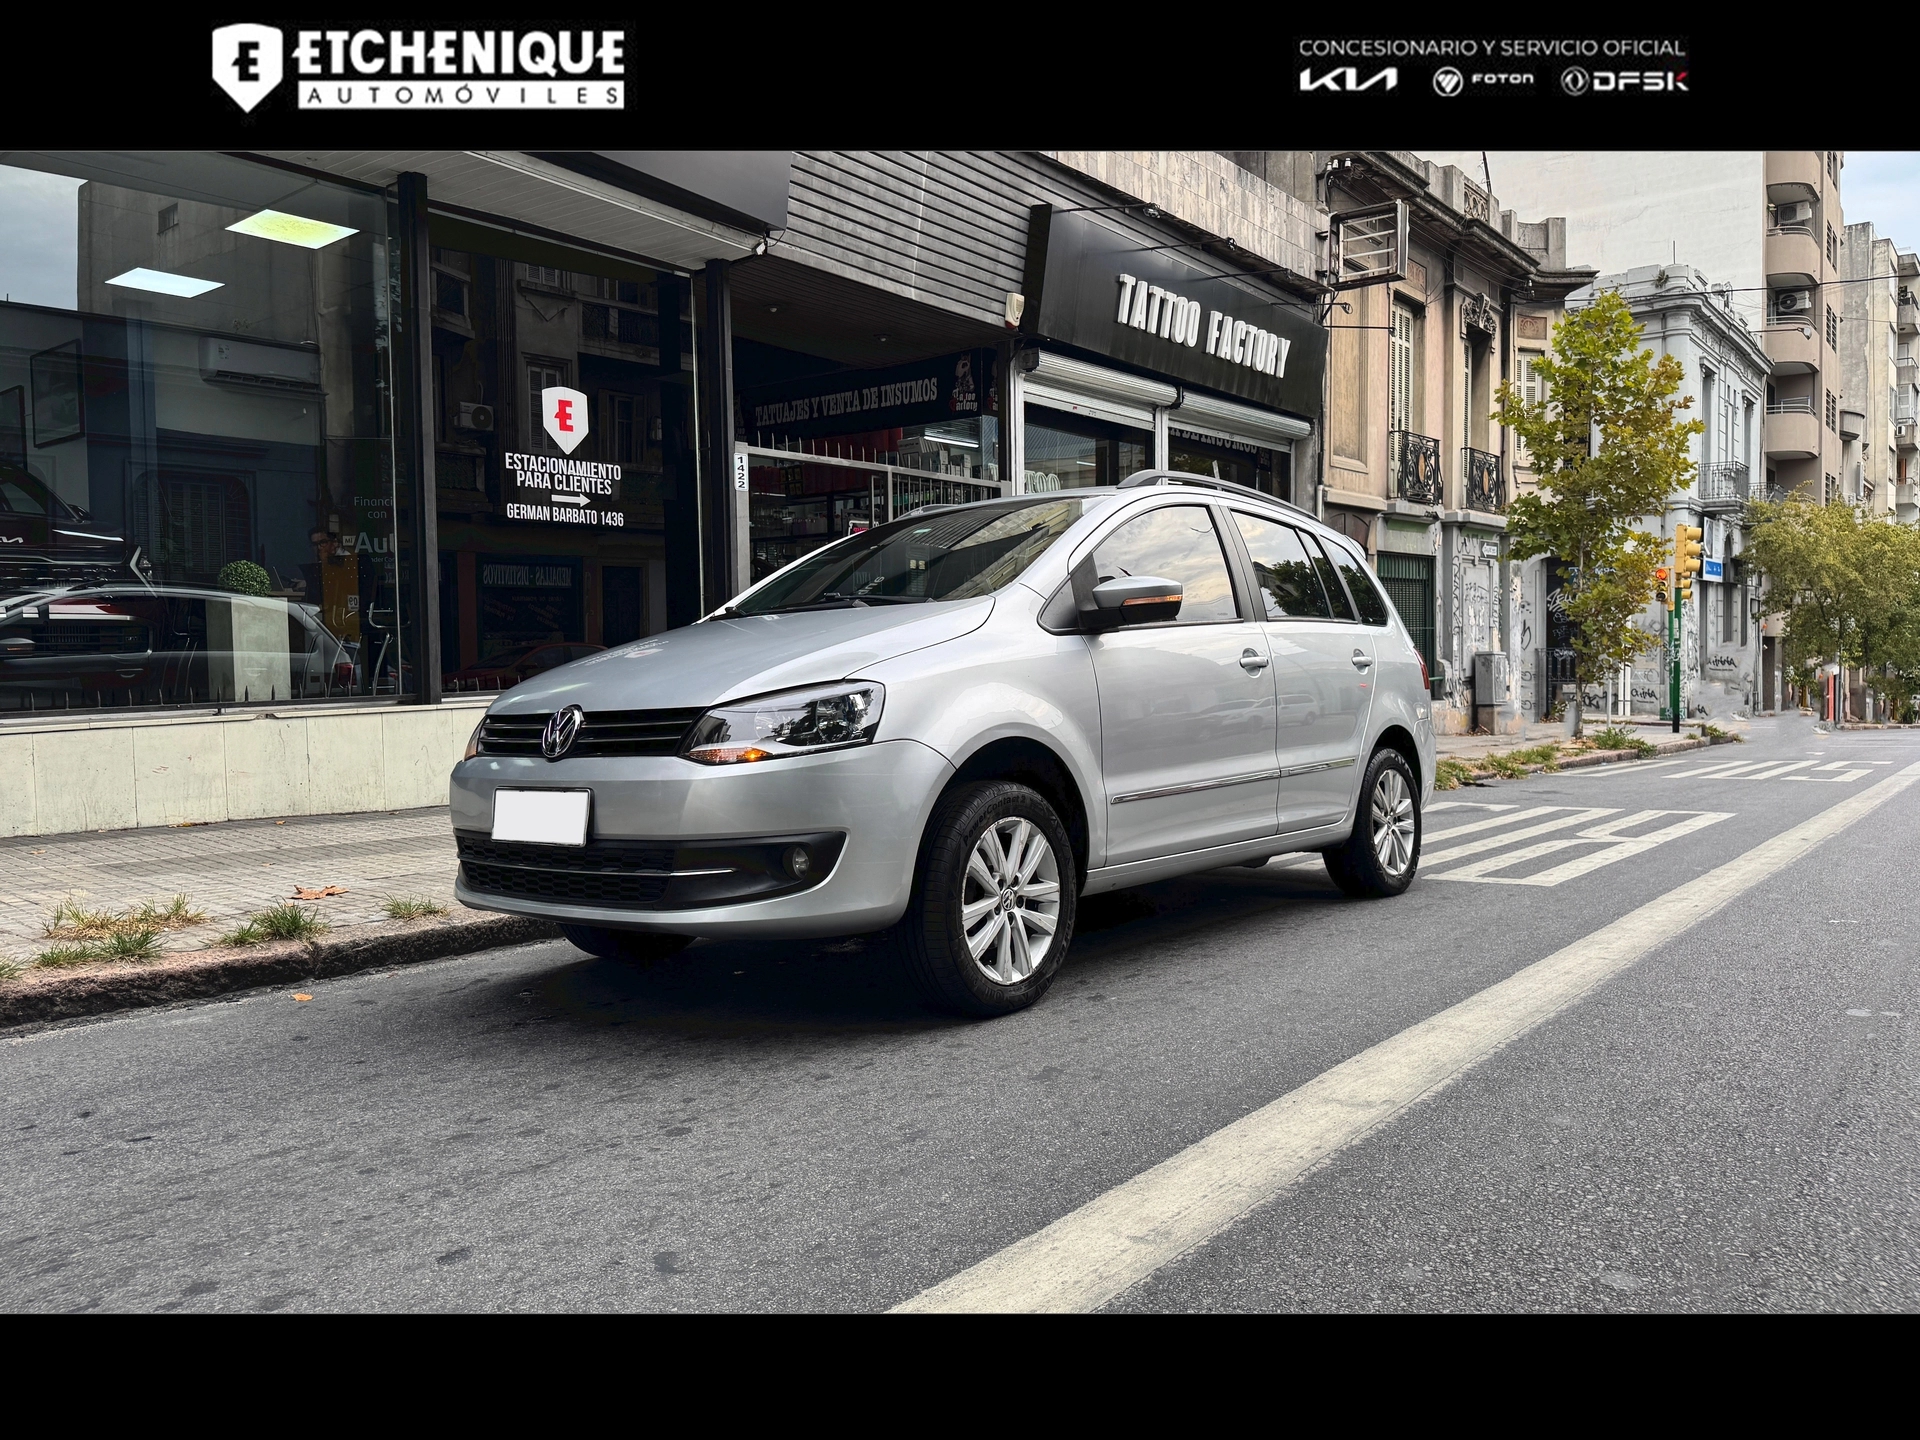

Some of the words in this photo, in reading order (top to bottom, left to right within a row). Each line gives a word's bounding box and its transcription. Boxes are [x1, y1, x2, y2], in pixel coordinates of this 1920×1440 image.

[1117, 273, 1201, 348] TATTOO
[1205, 310, 1292, 379] FACTORY
[755, 398, 810, 427] TATUAJES
[810, 396, 820, 419] Y
[820, 389, 860, 416] VENTA
[862, 386, 879, 409] DE
[880, 377, 939, 407] INSUMOS
[505, 452, 622, 481] ESTACIONAMIENTO
[736, 455, 746, 489] 1422
[516, 470, 552, 490] PARA
[554, 473, 612, 496] CLIENTES
[367, 510, 387, 519] con
[506, 503, 551, 521] GERMAN
[552, 506, 598, 525] BARBATO
[600, 510, 624, 527] 1436
